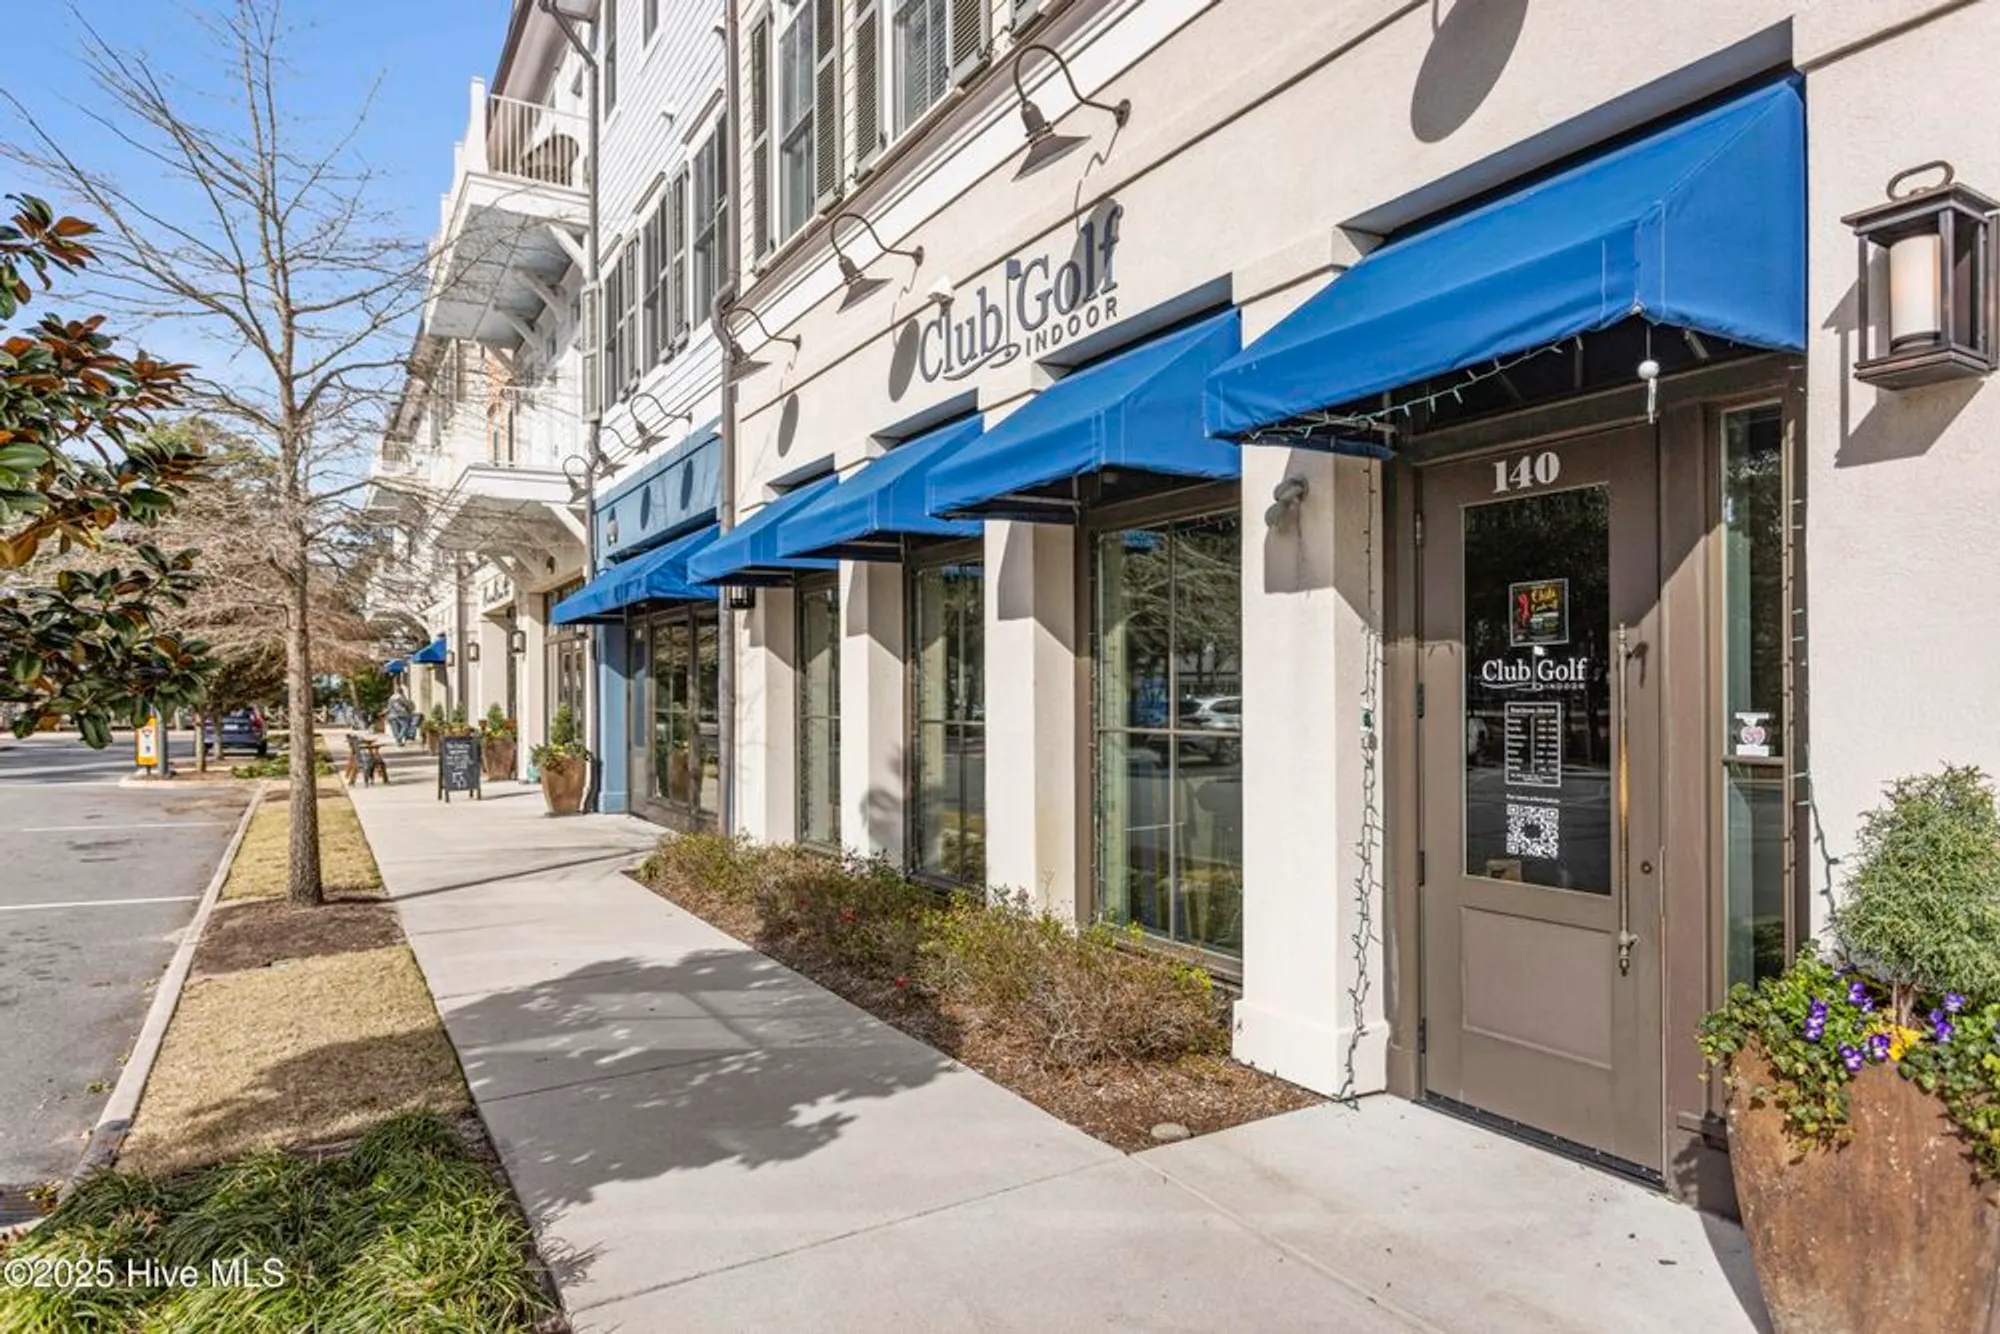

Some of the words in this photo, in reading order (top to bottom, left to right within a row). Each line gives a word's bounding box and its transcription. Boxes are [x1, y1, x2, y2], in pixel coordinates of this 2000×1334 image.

[918, 286, 1003, 383] Club
[1016, 203, 1125, 332] Golf
[1026, 297, 1118, 357] INDOOR
[1492, 451, 1561, 494] 140
[1482, 658, 1531, 681] Club
[1537, 656, 1588, 681] Golf
